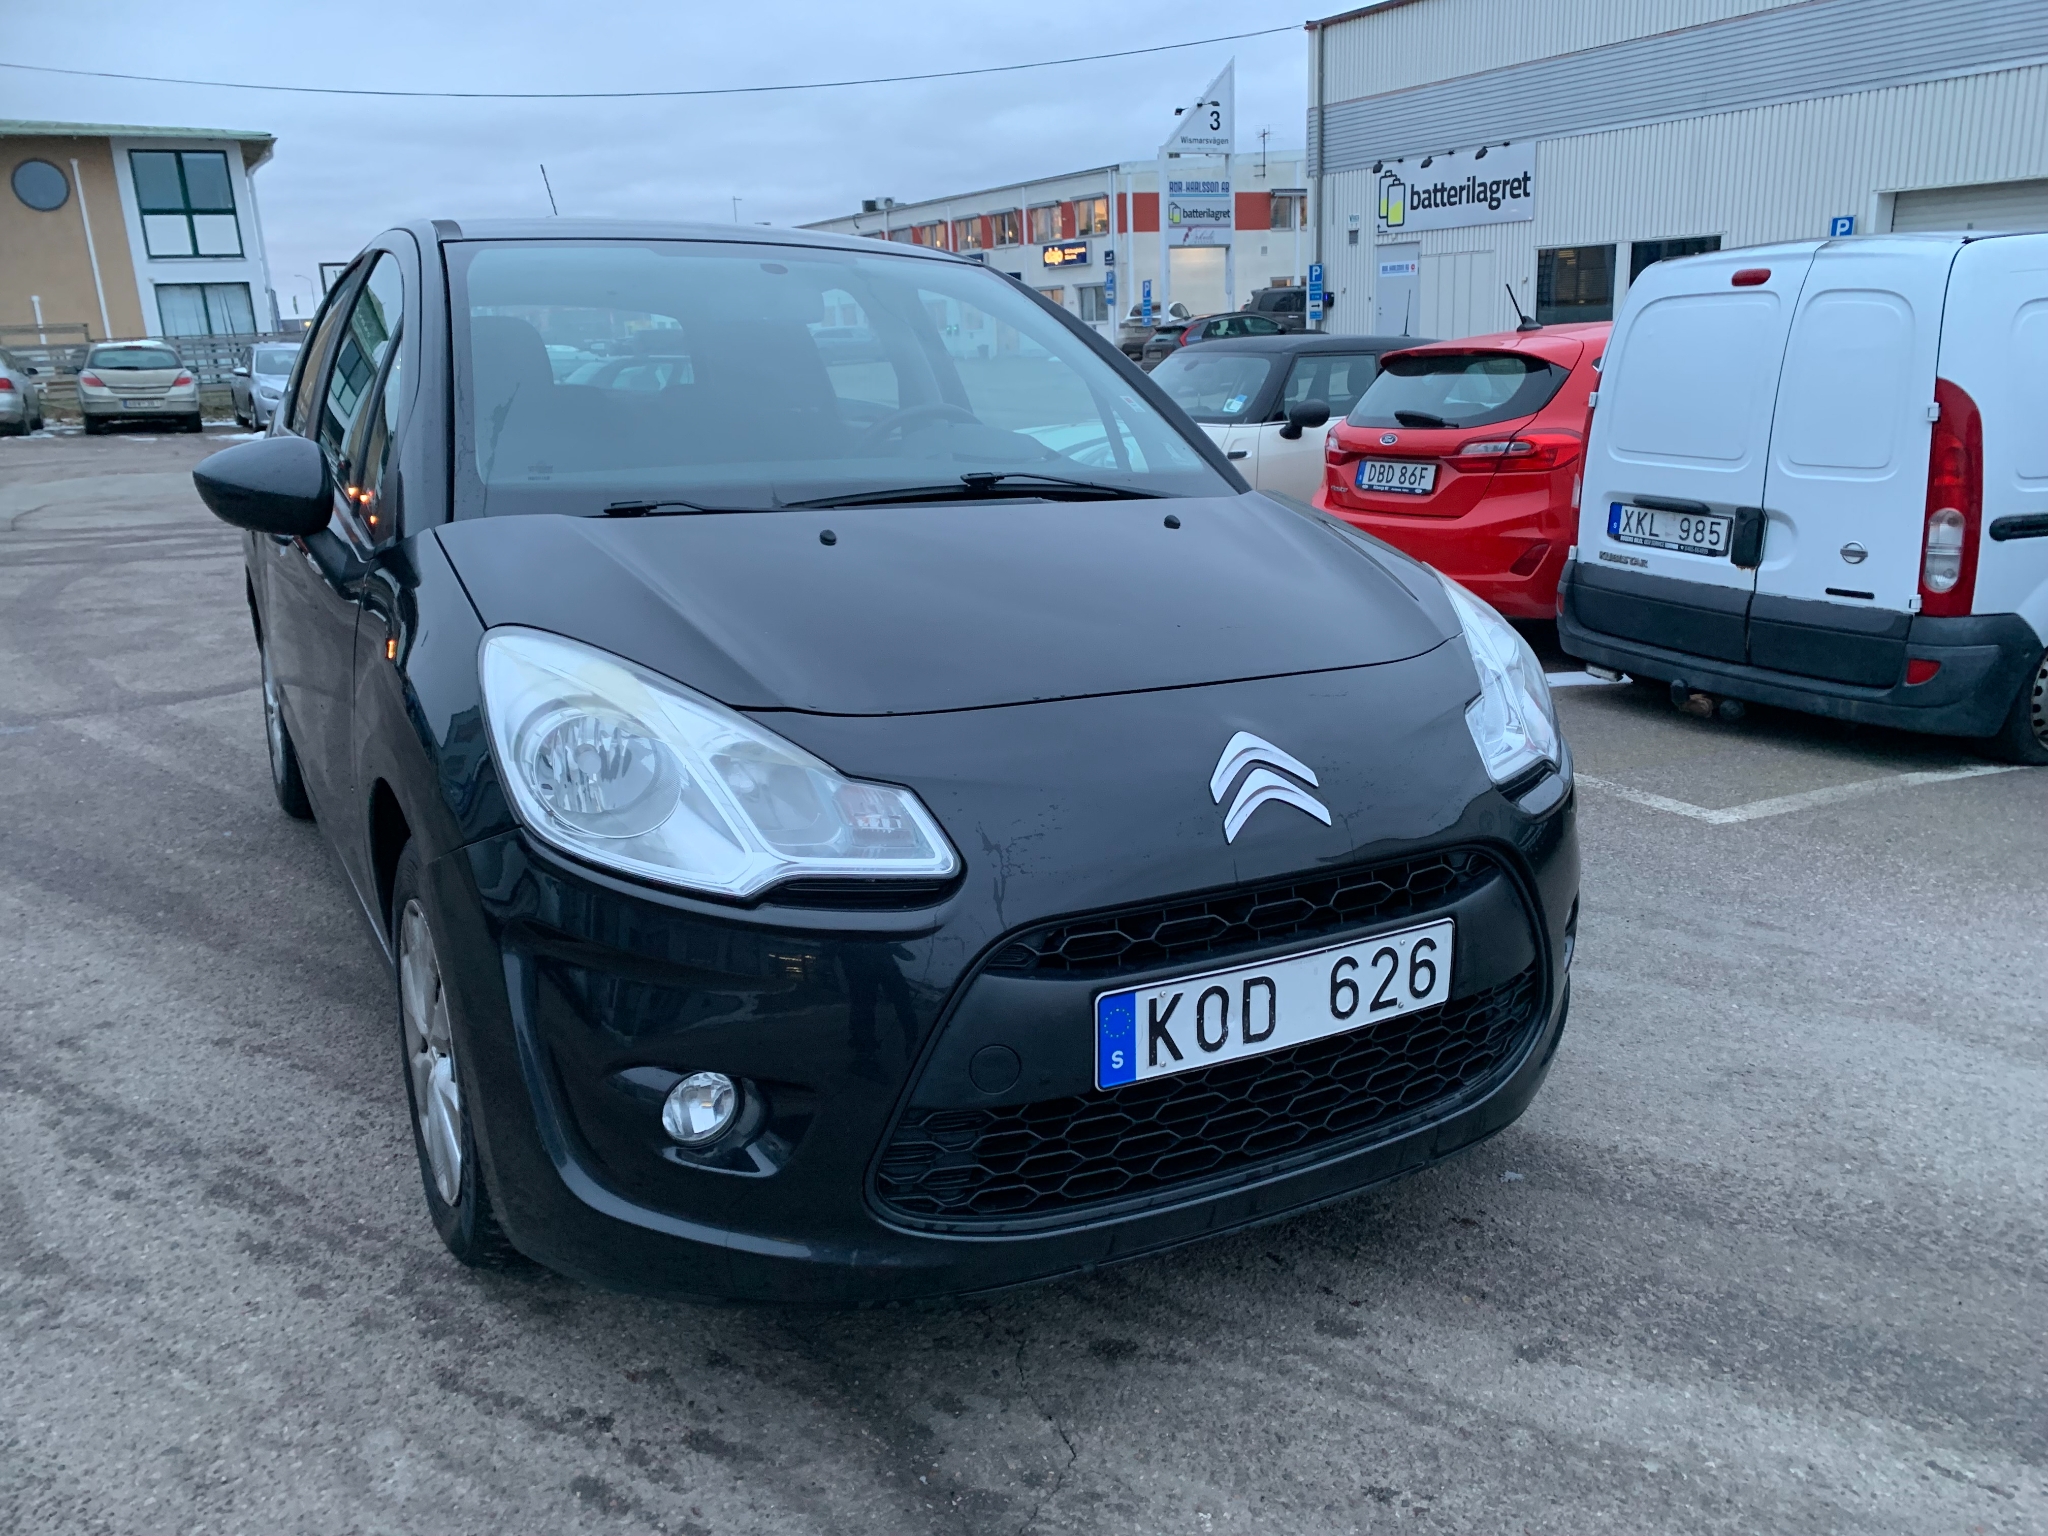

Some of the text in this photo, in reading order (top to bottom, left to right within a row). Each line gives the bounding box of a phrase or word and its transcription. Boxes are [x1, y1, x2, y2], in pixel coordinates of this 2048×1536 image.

[1209, 110, 1221, 131] 3
[1180, 135, 1229, 146] Wismarsvägen
[1221, 181, 1230, 193] AB
[1409, 170, 1532, 211] batterilagret
[1182, 208, 1231, 222] batterilagret
[1835, 219, 1850, 237] P
[1312, 266, 1321, 281] P
[1368, 463, 1429, 487] DBD 86F
[1622, 509, 1660, 538] XKL
[1678, 517, 1722, 546] 985
[1147, 937, 1438, 1068] KOD 626
[1111, 1050, 1124, 1070] S
